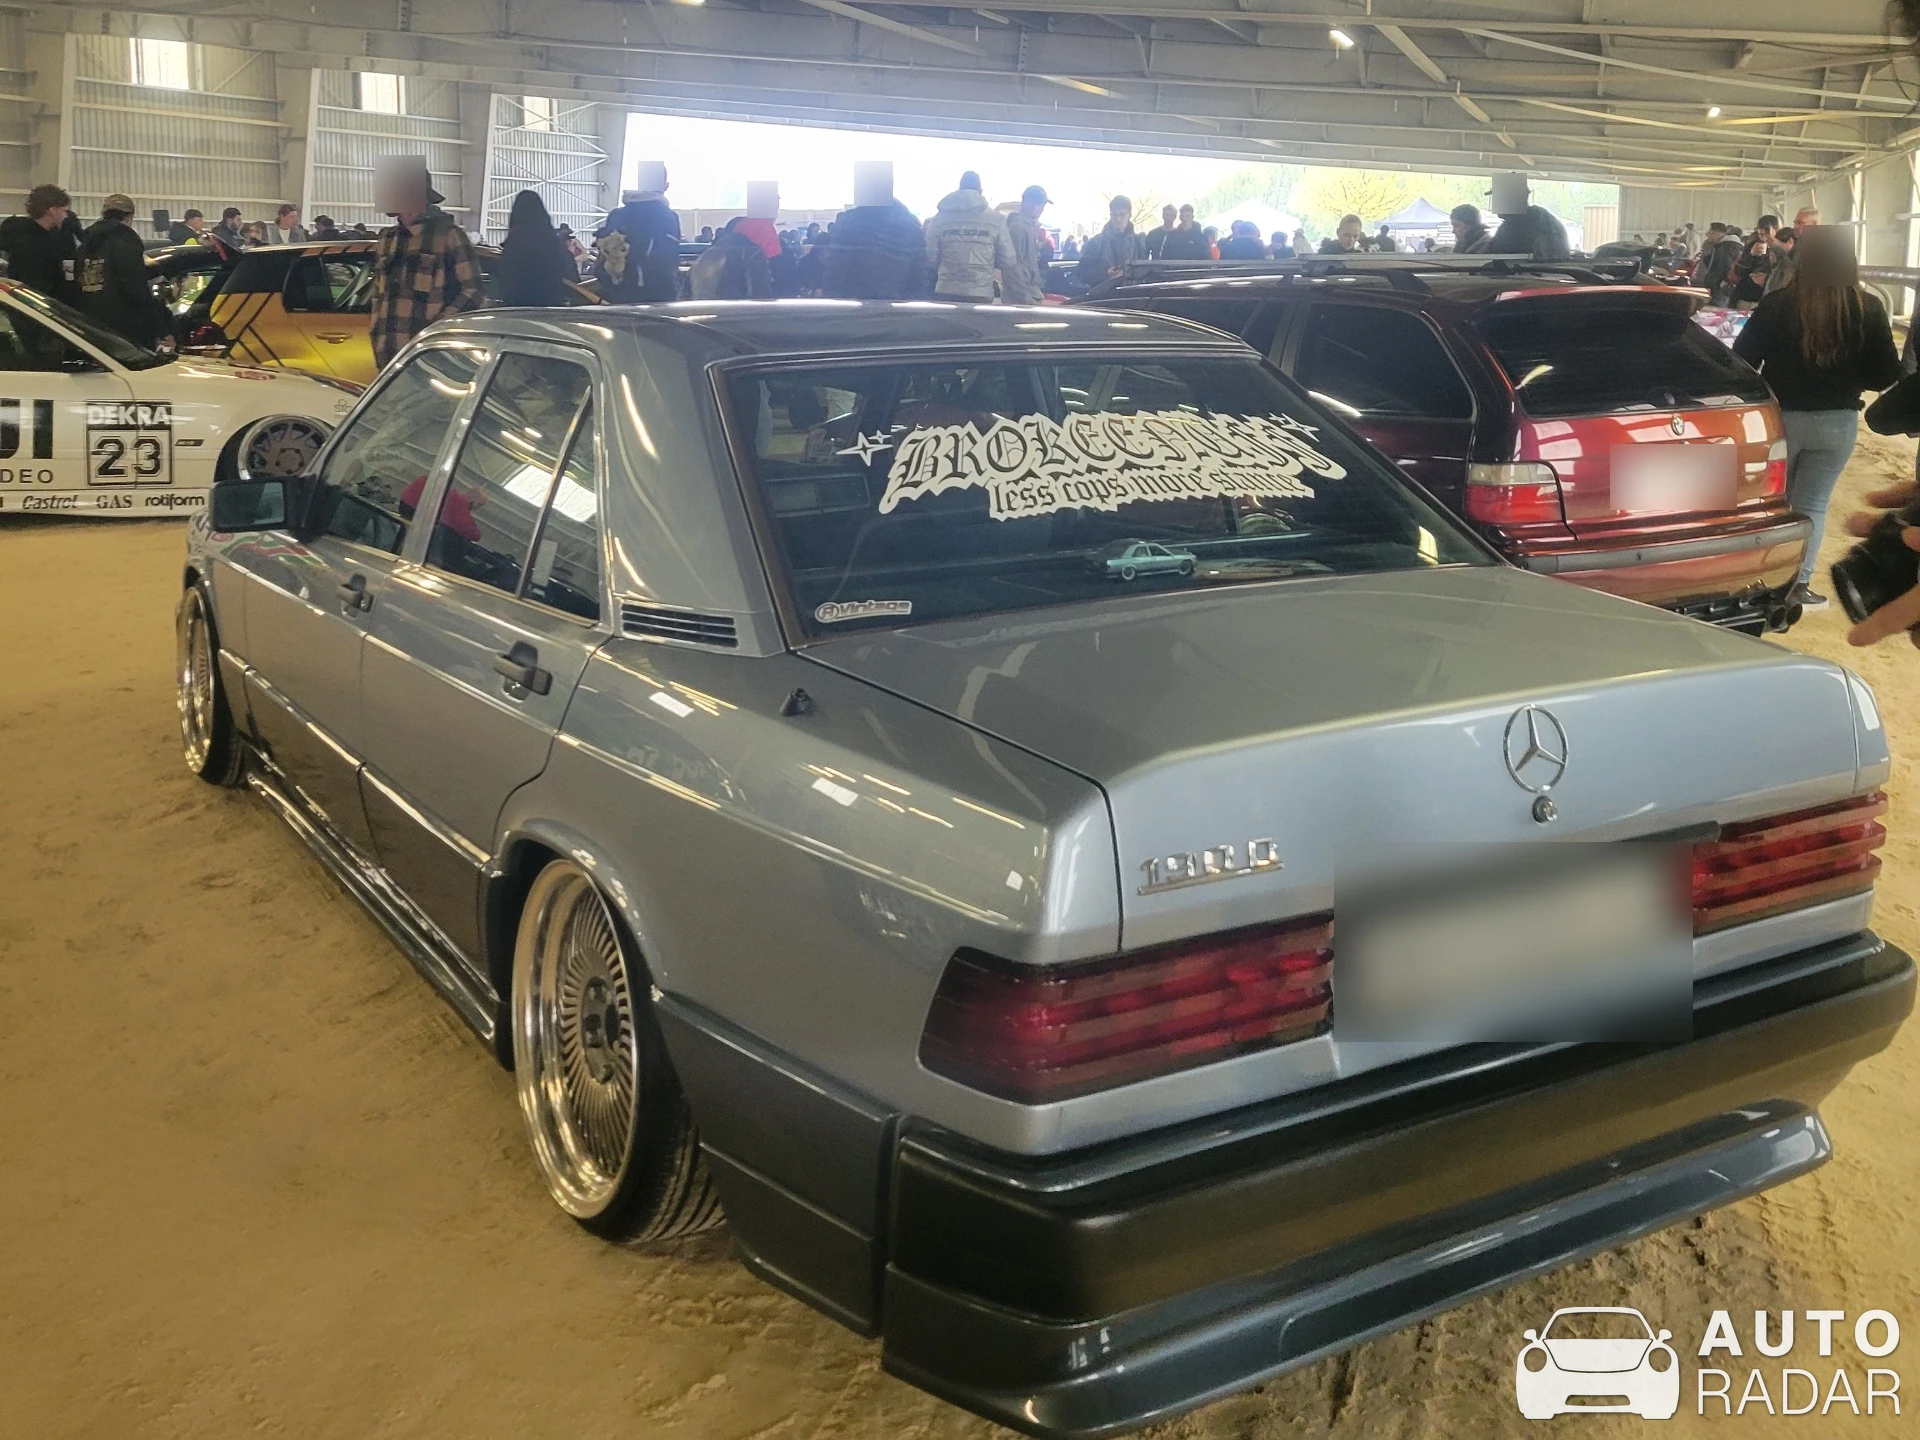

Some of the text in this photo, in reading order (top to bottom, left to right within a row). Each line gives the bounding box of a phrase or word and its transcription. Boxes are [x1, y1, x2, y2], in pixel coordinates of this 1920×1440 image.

[88, 406, 170, 426] DEKRA
[92, 438, 161, 475] 23
[22, 493, 204, 510] Castrol GAS rotiform
[995, 466, 1305, 513] less cops more stance
